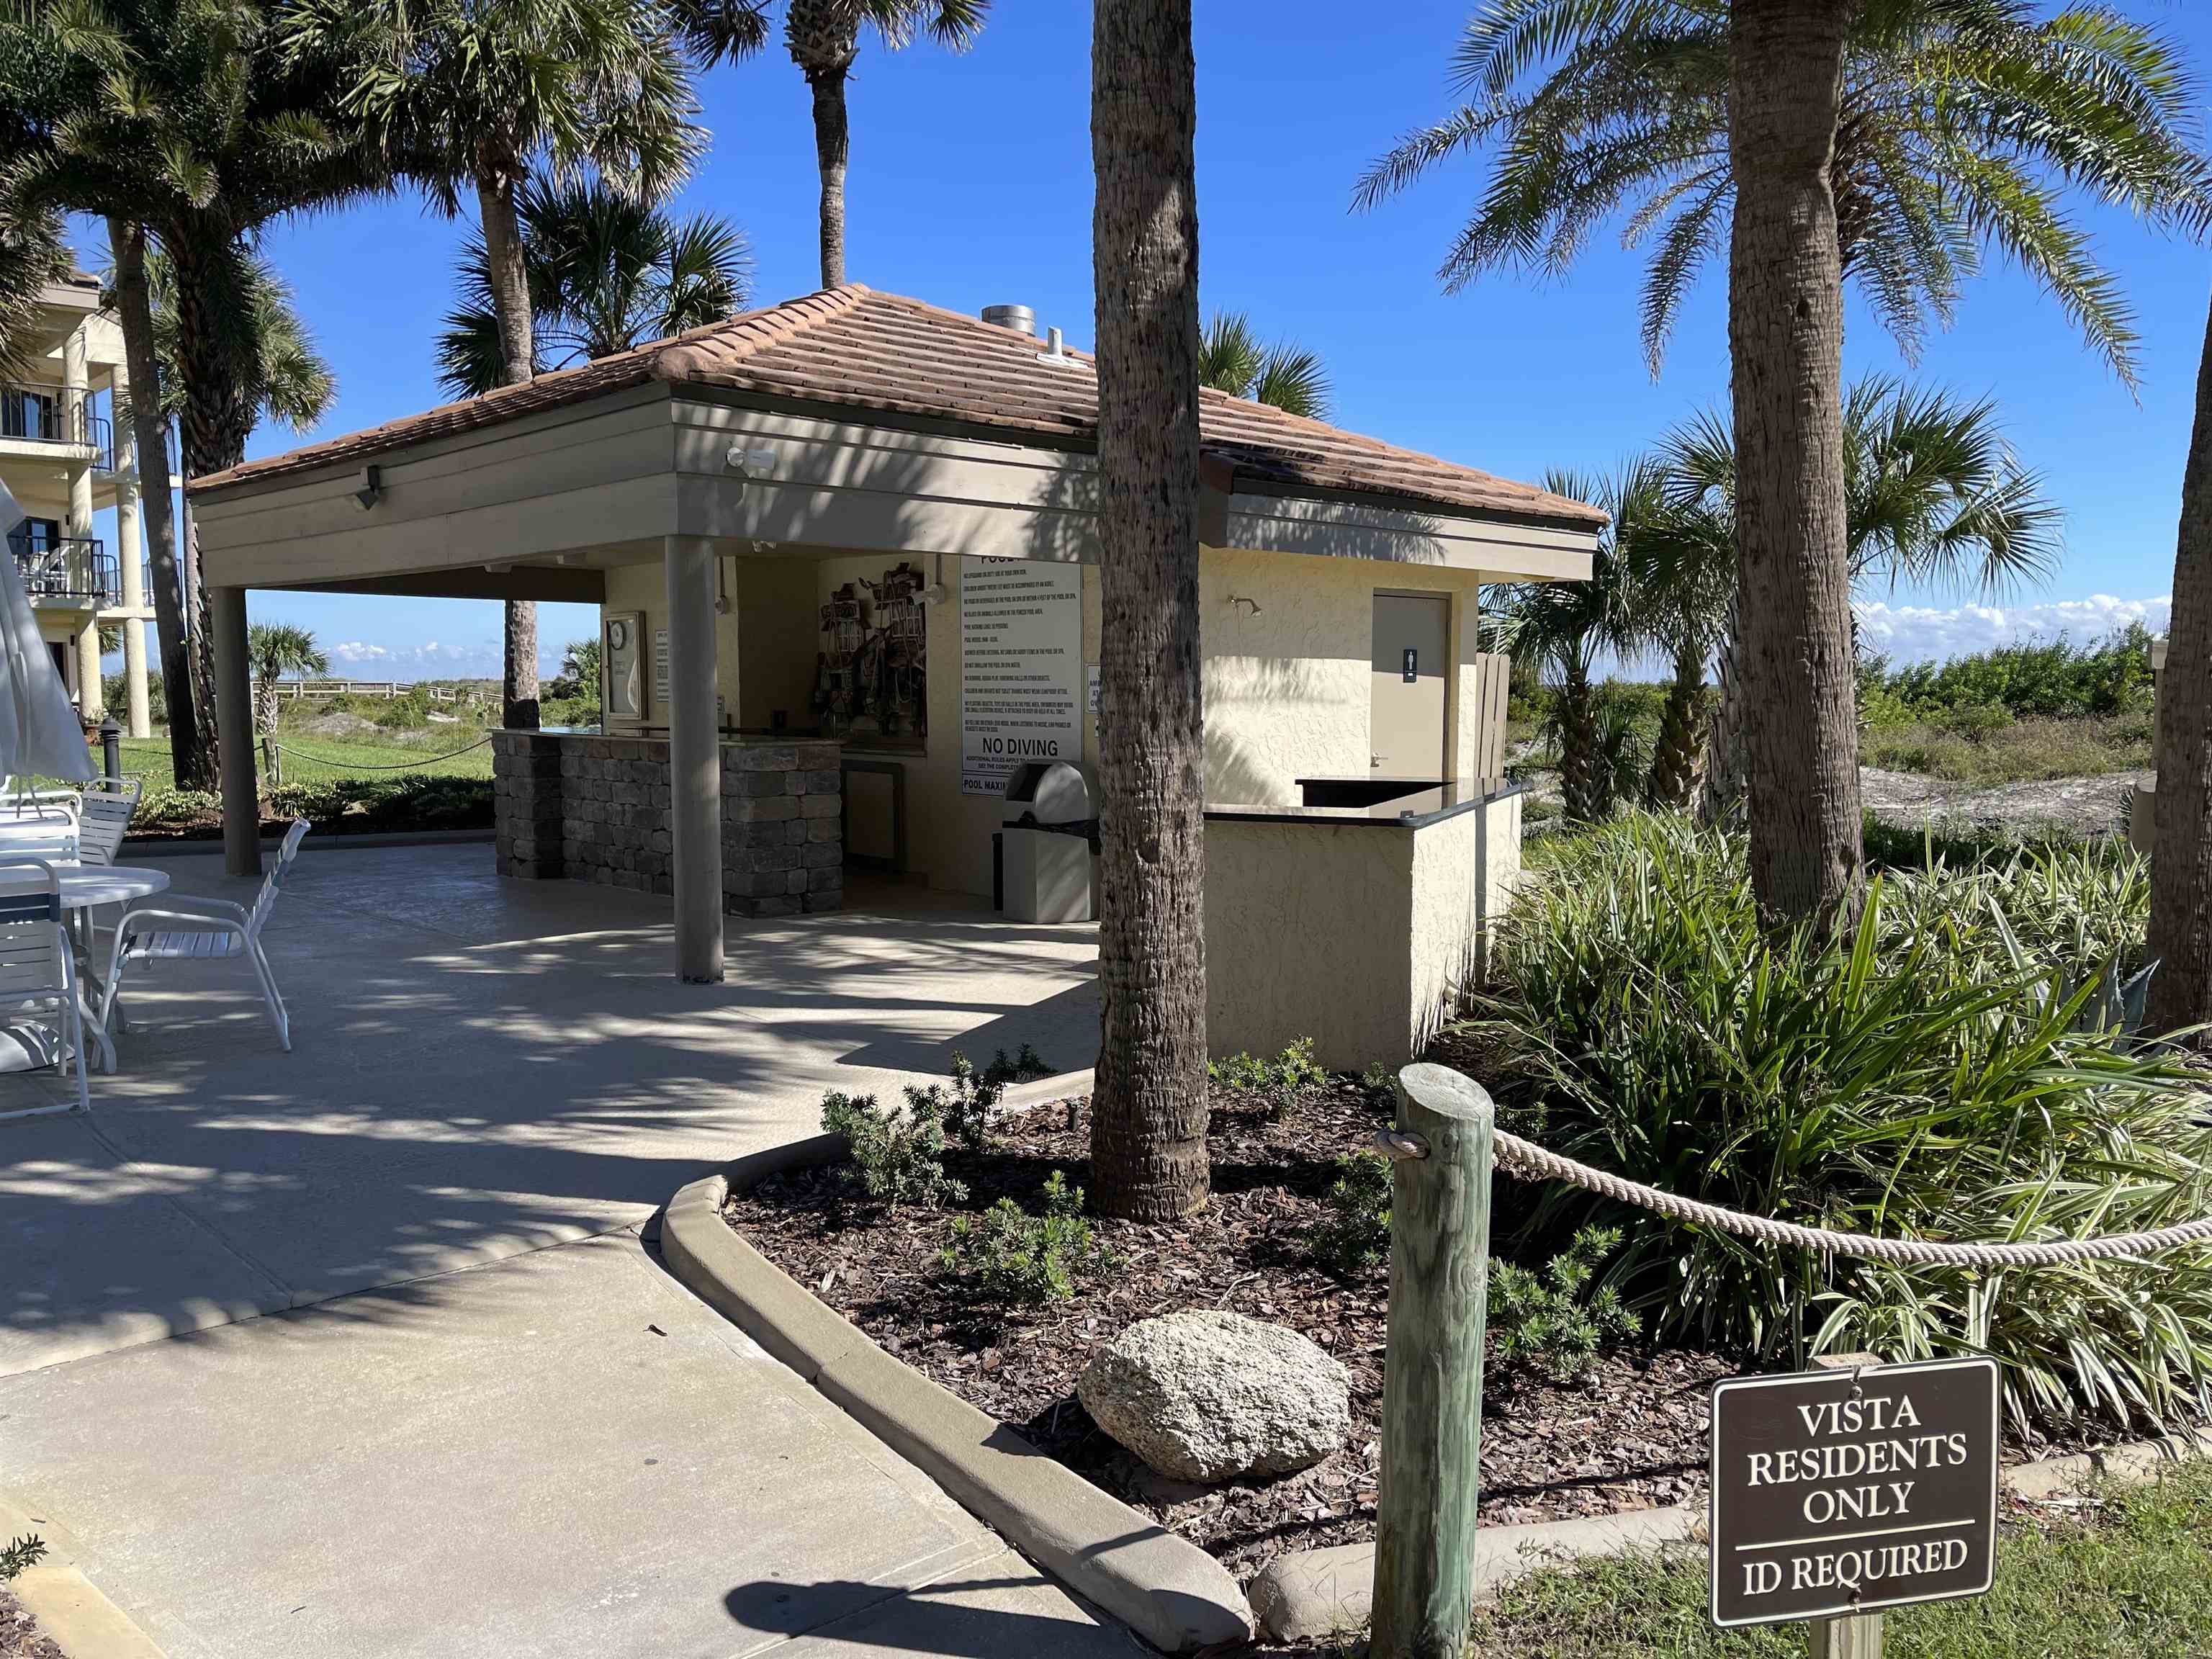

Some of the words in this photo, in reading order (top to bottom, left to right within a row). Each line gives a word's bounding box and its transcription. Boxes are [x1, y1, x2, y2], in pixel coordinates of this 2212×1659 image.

[982, 737, 1003, 754] NO
[1007, 739, 1058, 756] DIVING
[963, 779, 982, 789] POOL
[1797, 1394, 1921, 1437] VISTA
[1747, 1433, 1967, 1487] RESIDENTS
[1803, 1480, 1915, 1524] ONLY
[1743, 1561, 1782, 1596] ID
[1791, 1538, 1968, 1589] REQUIRED
